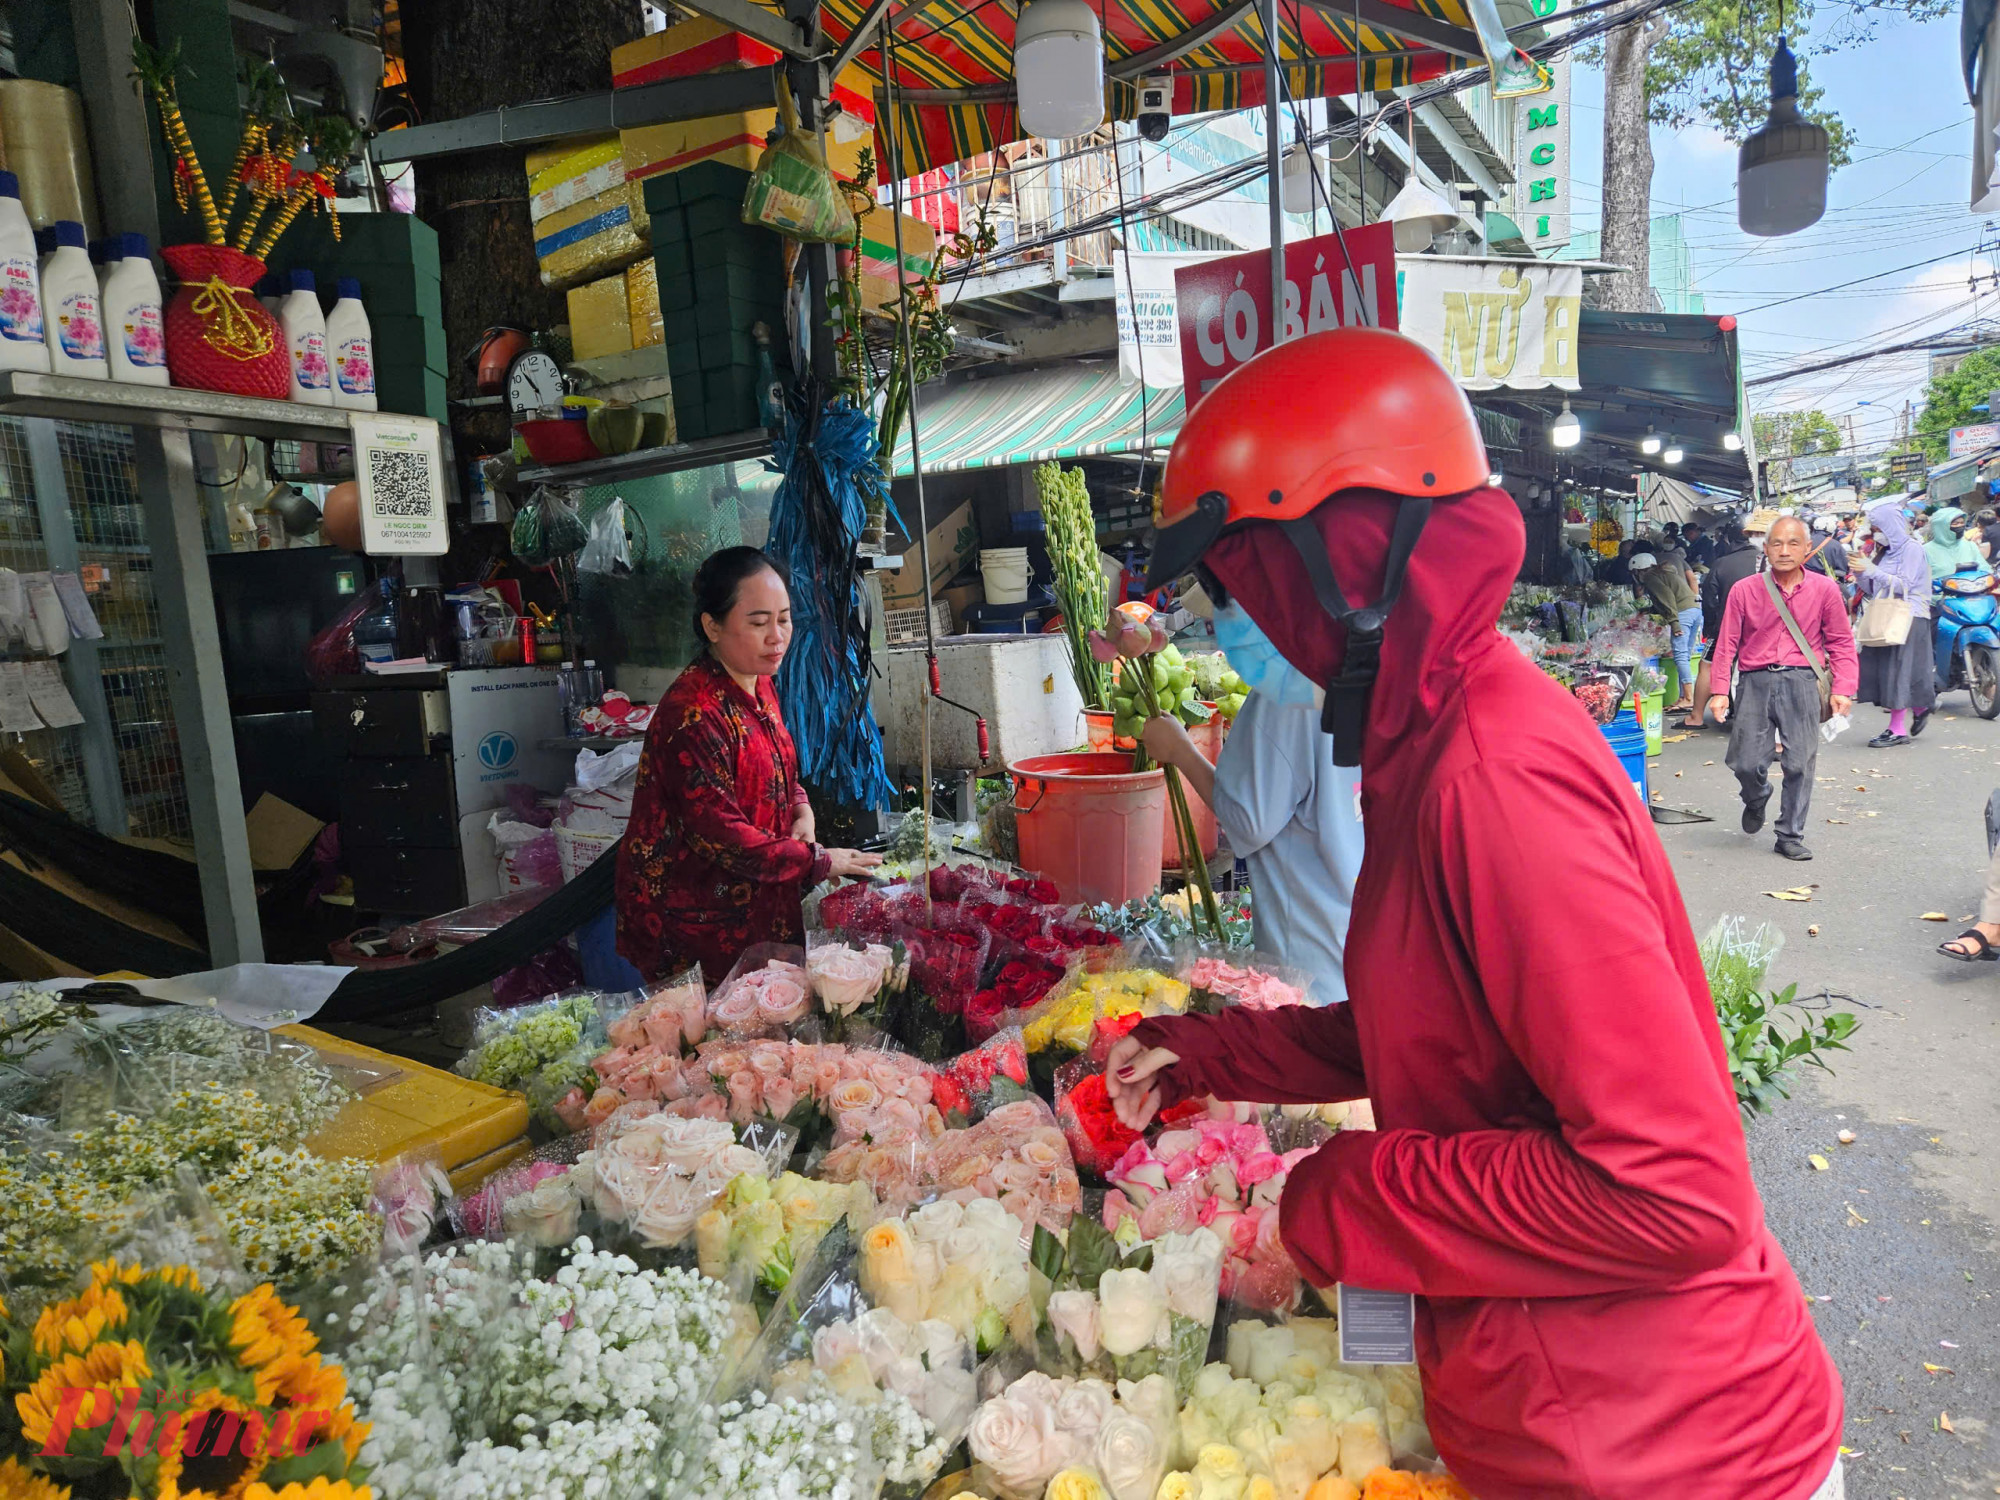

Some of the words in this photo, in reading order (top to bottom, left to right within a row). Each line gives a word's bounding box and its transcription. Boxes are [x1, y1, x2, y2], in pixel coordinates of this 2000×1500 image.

[6, 267, 29, 279] ASA
[1196, 270, 1259, 367] CÓ
[1285, 253, 1379, 341] BÁN
[528, 356, 538, 366] 12
[550, 368, 558, 378] 2
[513, 375, 522, 384] 10
[555, 382, 563, 392] 3
[512, 390, 520, 399] 9
